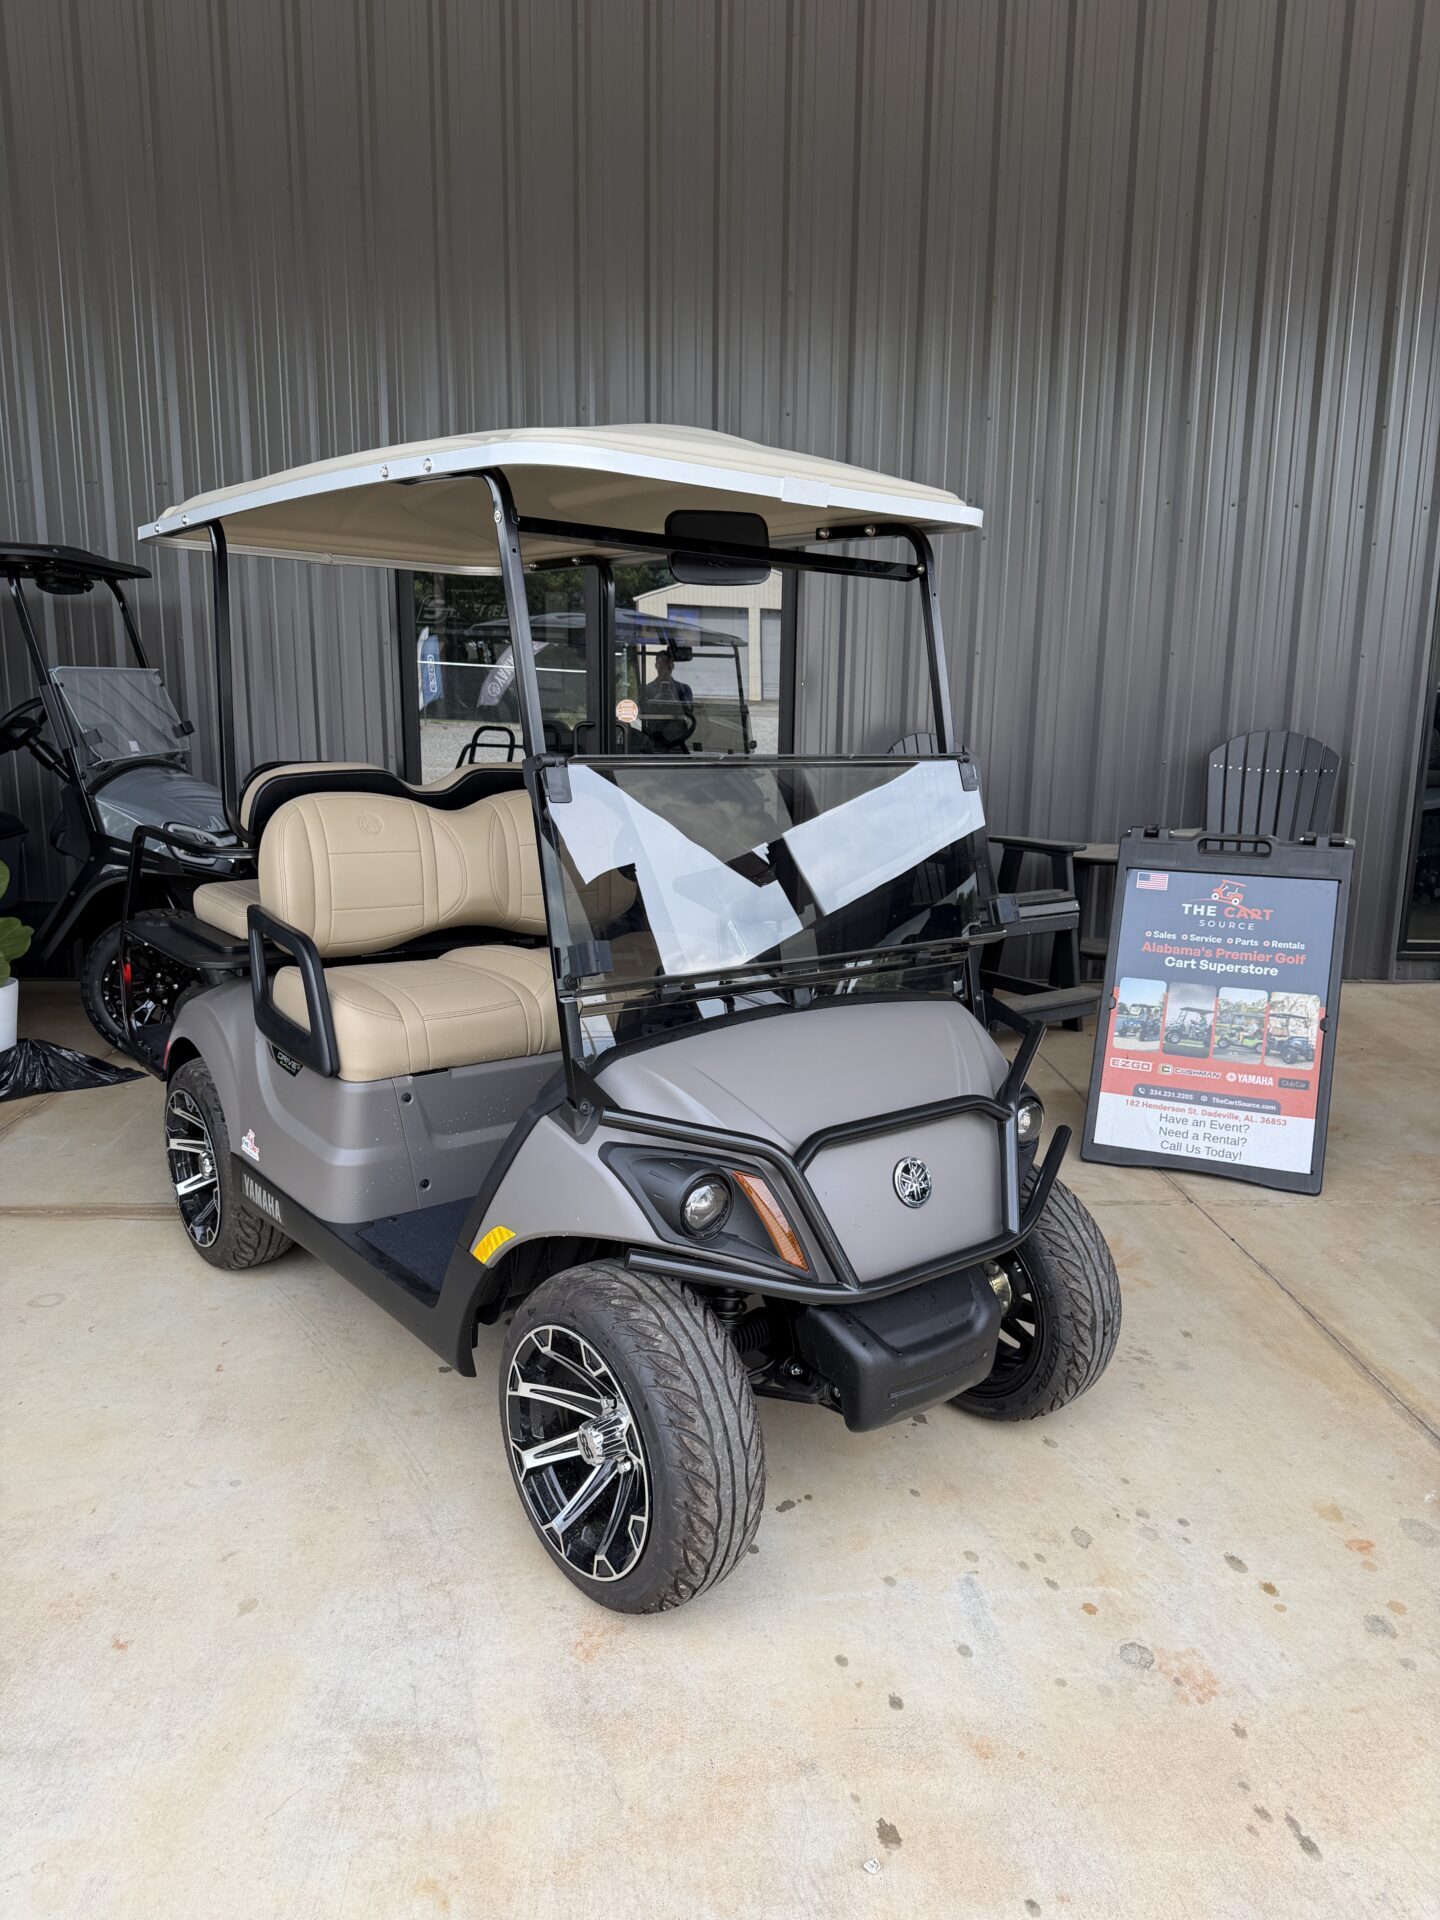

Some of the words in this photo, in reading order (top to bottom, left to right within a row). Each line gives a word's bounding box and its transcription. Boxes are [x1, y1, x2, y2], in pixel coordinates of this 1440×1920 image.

[1182, 903, 1217, 917] THE
[1224, 907, 1274, 921] CART
[1199, 920, 1255, 930] SOURCE
[1153, 930, 1177, 940] Sales
[1189, 934, 1222, 944] Service
[1235, 937, 1259, 947] Parts
[1271, 940, 1306, 950] Rentals
[1142, 942, 1213, 958] Alabama's
[1215, 948, 1273, 963] Premier
[1274, 952, 1307, 965] Golf
[1165, 956, 1197, 969] Cart
[1199, 959, 1279, 976] Superstore
[1111, 1058, 1151, 1071] EZGO
[1175, 1067, 1220, 1079] CUSHMAN
[1237, 1073, 1274, 1087] YAMAHA
[1125, 1099, 1139, 1107] 182
[1142, 1101, 1186, 1114] Henderson
[1187, 1107, 1199, 1116] St.
[1201, 1109, 1241, 1122] Dadeville,
[1244, 1115, 1258, 1123] AL.
[1260, 1116, 1287, 1127] 36853
[1212, 1097, 1277, 1111] TheCartSource.com
[1159, 1113, 1188, 1126] Have
[1192, 1119, 1206, 1128] an
[1209, 1120, 1250, 1134] Event?
[1159, 1126, 1189, 1139] Need
[1192, 1132, 1199, 1141] a
[1203, 1132, 1248, 1147] Rental?
[1160, 1140, 1182, 1151] Call
[1185, 1143, 1201, 1154] Us
[1205, 1146, 1243, 1161] Today!
[243, 1173, 283, 1223] YAMAHA
